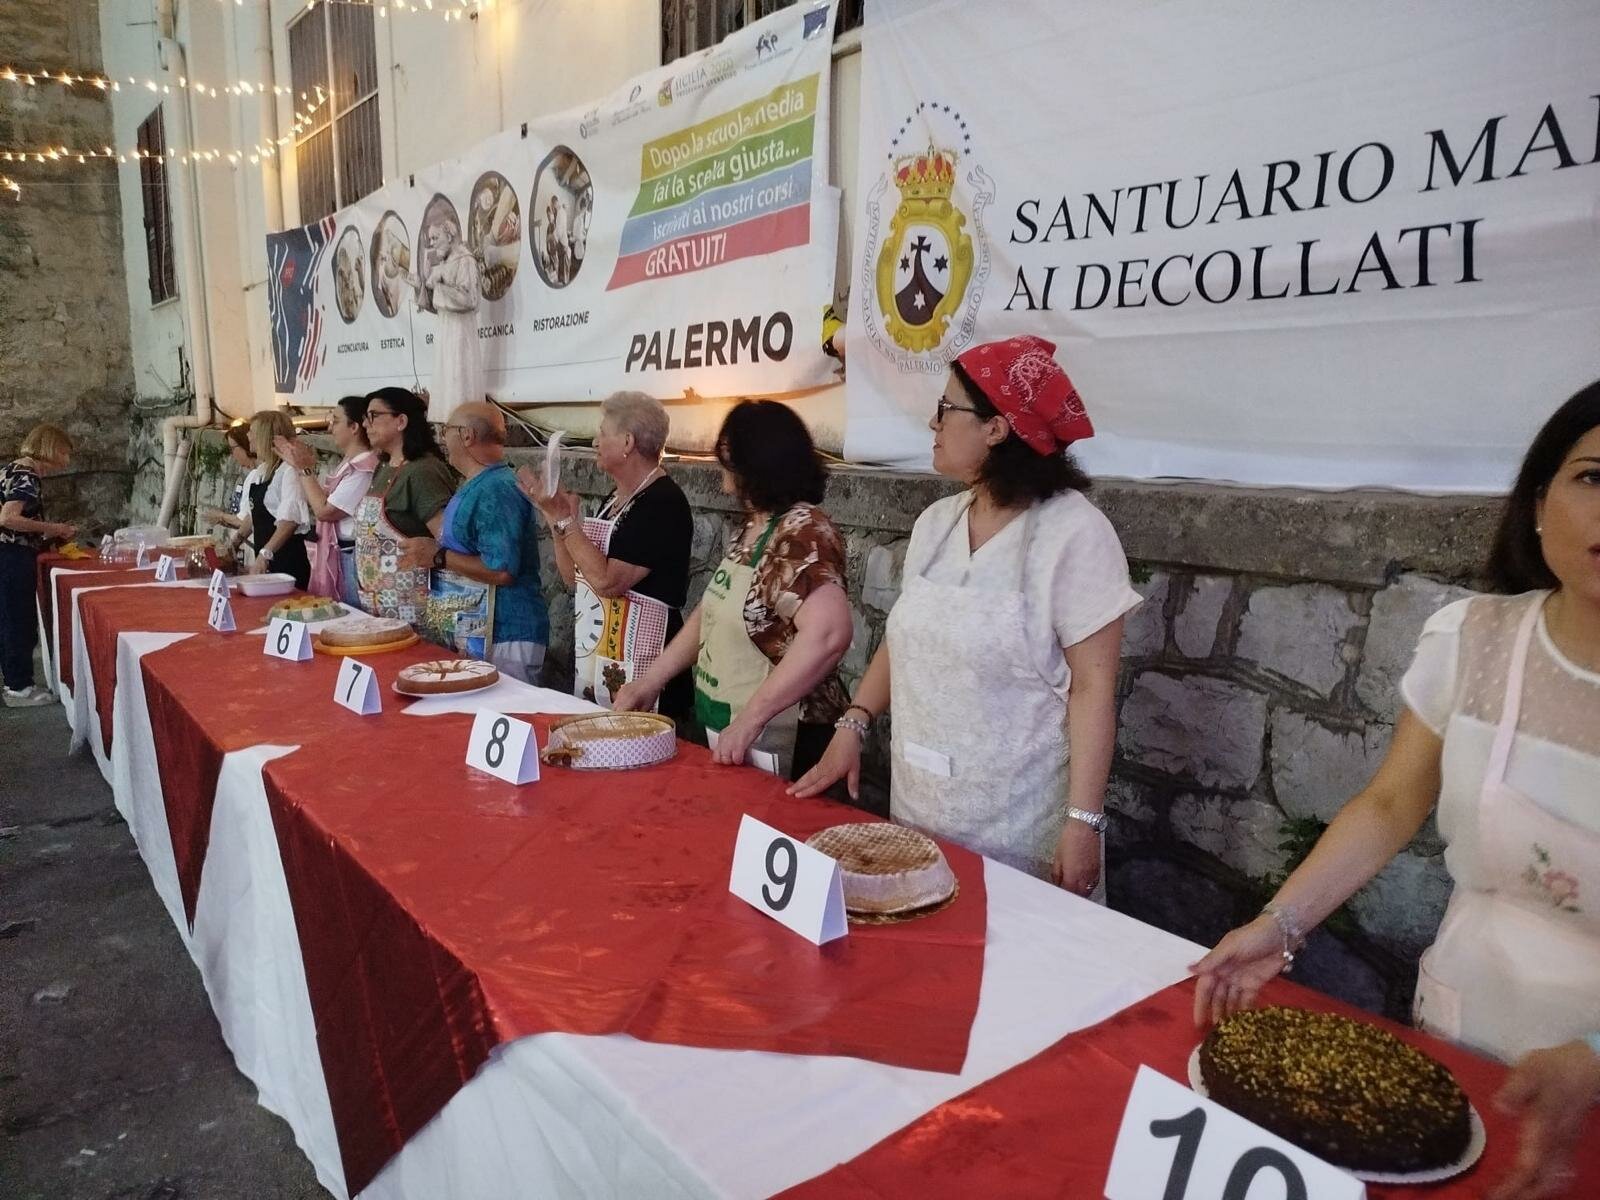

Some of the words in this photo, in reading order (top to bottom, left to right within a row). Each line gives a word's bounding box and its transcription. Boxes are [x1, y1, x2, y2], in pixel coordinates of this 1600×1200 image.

[649, 143, 690, 170] Dopo
[691, 131, 703, 154] la
[1009, 142, 1395, 244] SANTUARIO
[1417, 94, 1600, 194] MA
[652, 177, 672, 206] fai
[672, 174, 685, 199] la
[692, 201, 706, 226] ai
[710, 188, 753, 222] nostri
[757, 174, 794, 208] corsi
[645, 232, 727, 277] GRATUITI
[1003, 265, 1060, 311] AI
[1070, 218, 1485, 310] DECOLLATI
[533, 311, 589, 332] RISTORAZIONE
[625, 311, 793, 373] PALERMO
[954, 293, 981, 347] CARMELO
[380, 337, 405, 350] ESTETICA
[899, 360, 941, 372] PALERMO
[276, 622, 293, 655] 6
[346, 663, 363, 703] 7
[485, 717, 510, 769] 8
[761, 837, 798, 911] 9
